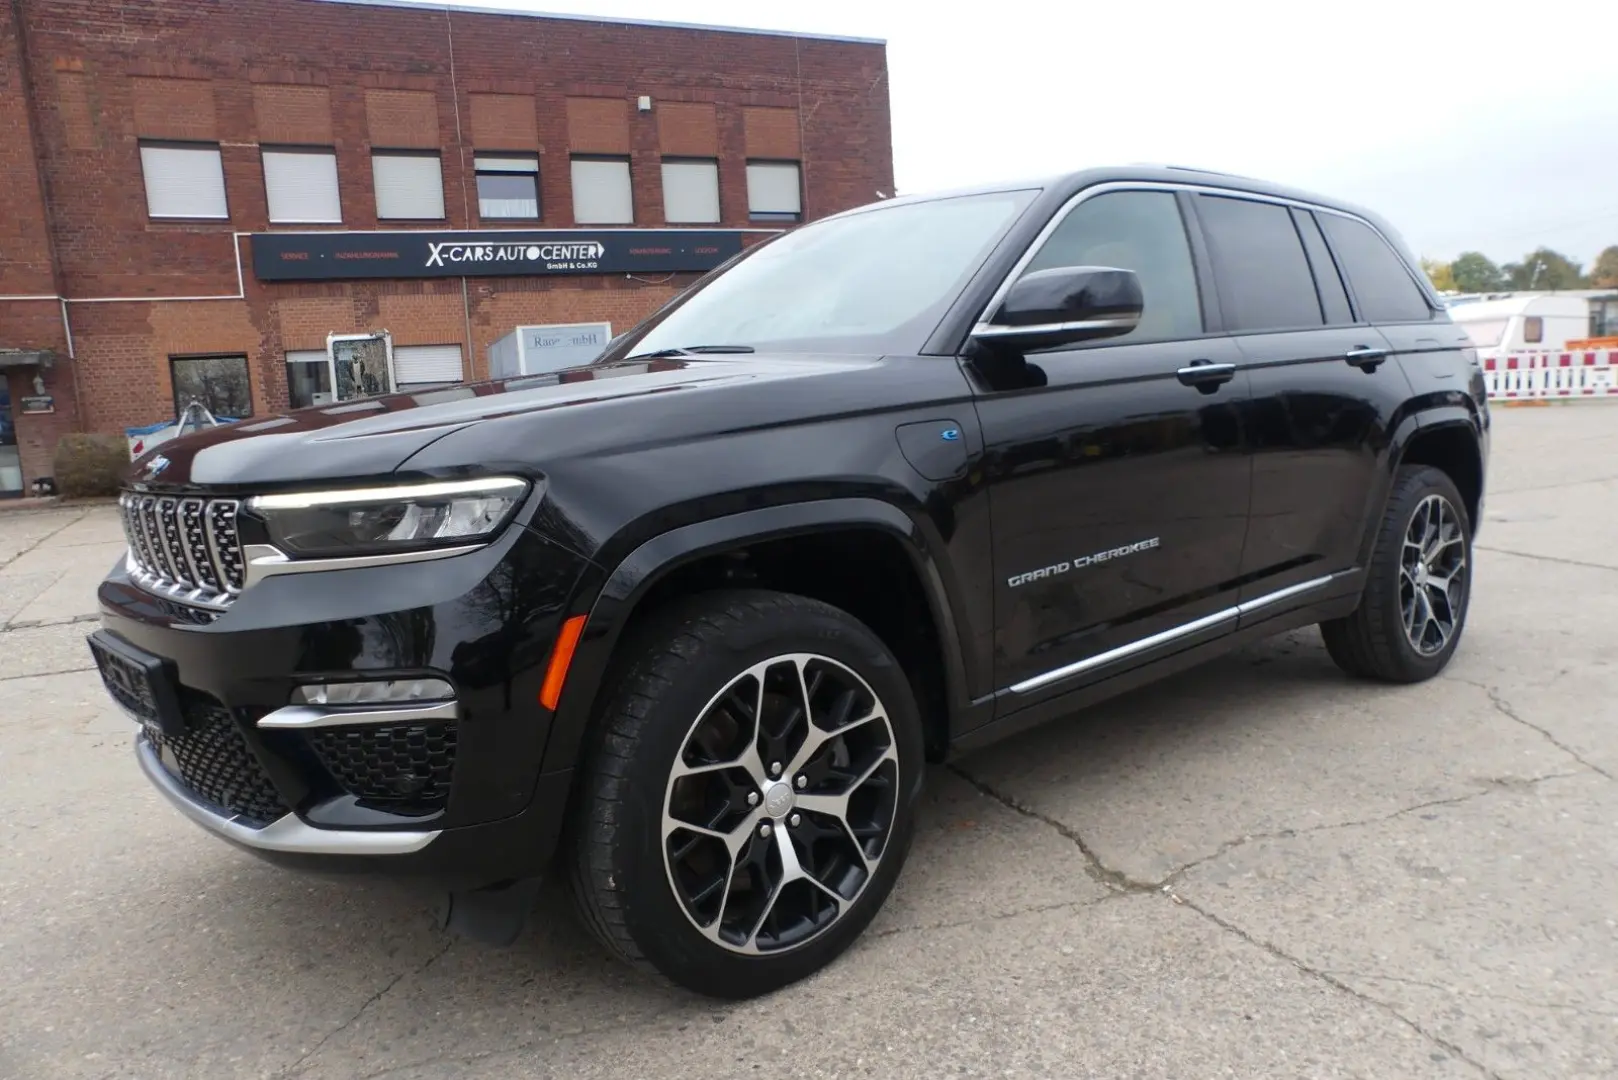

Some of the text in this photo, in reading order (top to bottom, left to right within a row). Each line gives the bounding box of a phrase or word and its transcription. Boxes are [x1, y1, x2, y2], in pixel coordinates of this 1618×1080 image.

[425, 243, 493, 267] X-CARS
[546, 262, 567, 270] GmbH
[1007, 536, 1160, 588] GRAND CHEROKEE
